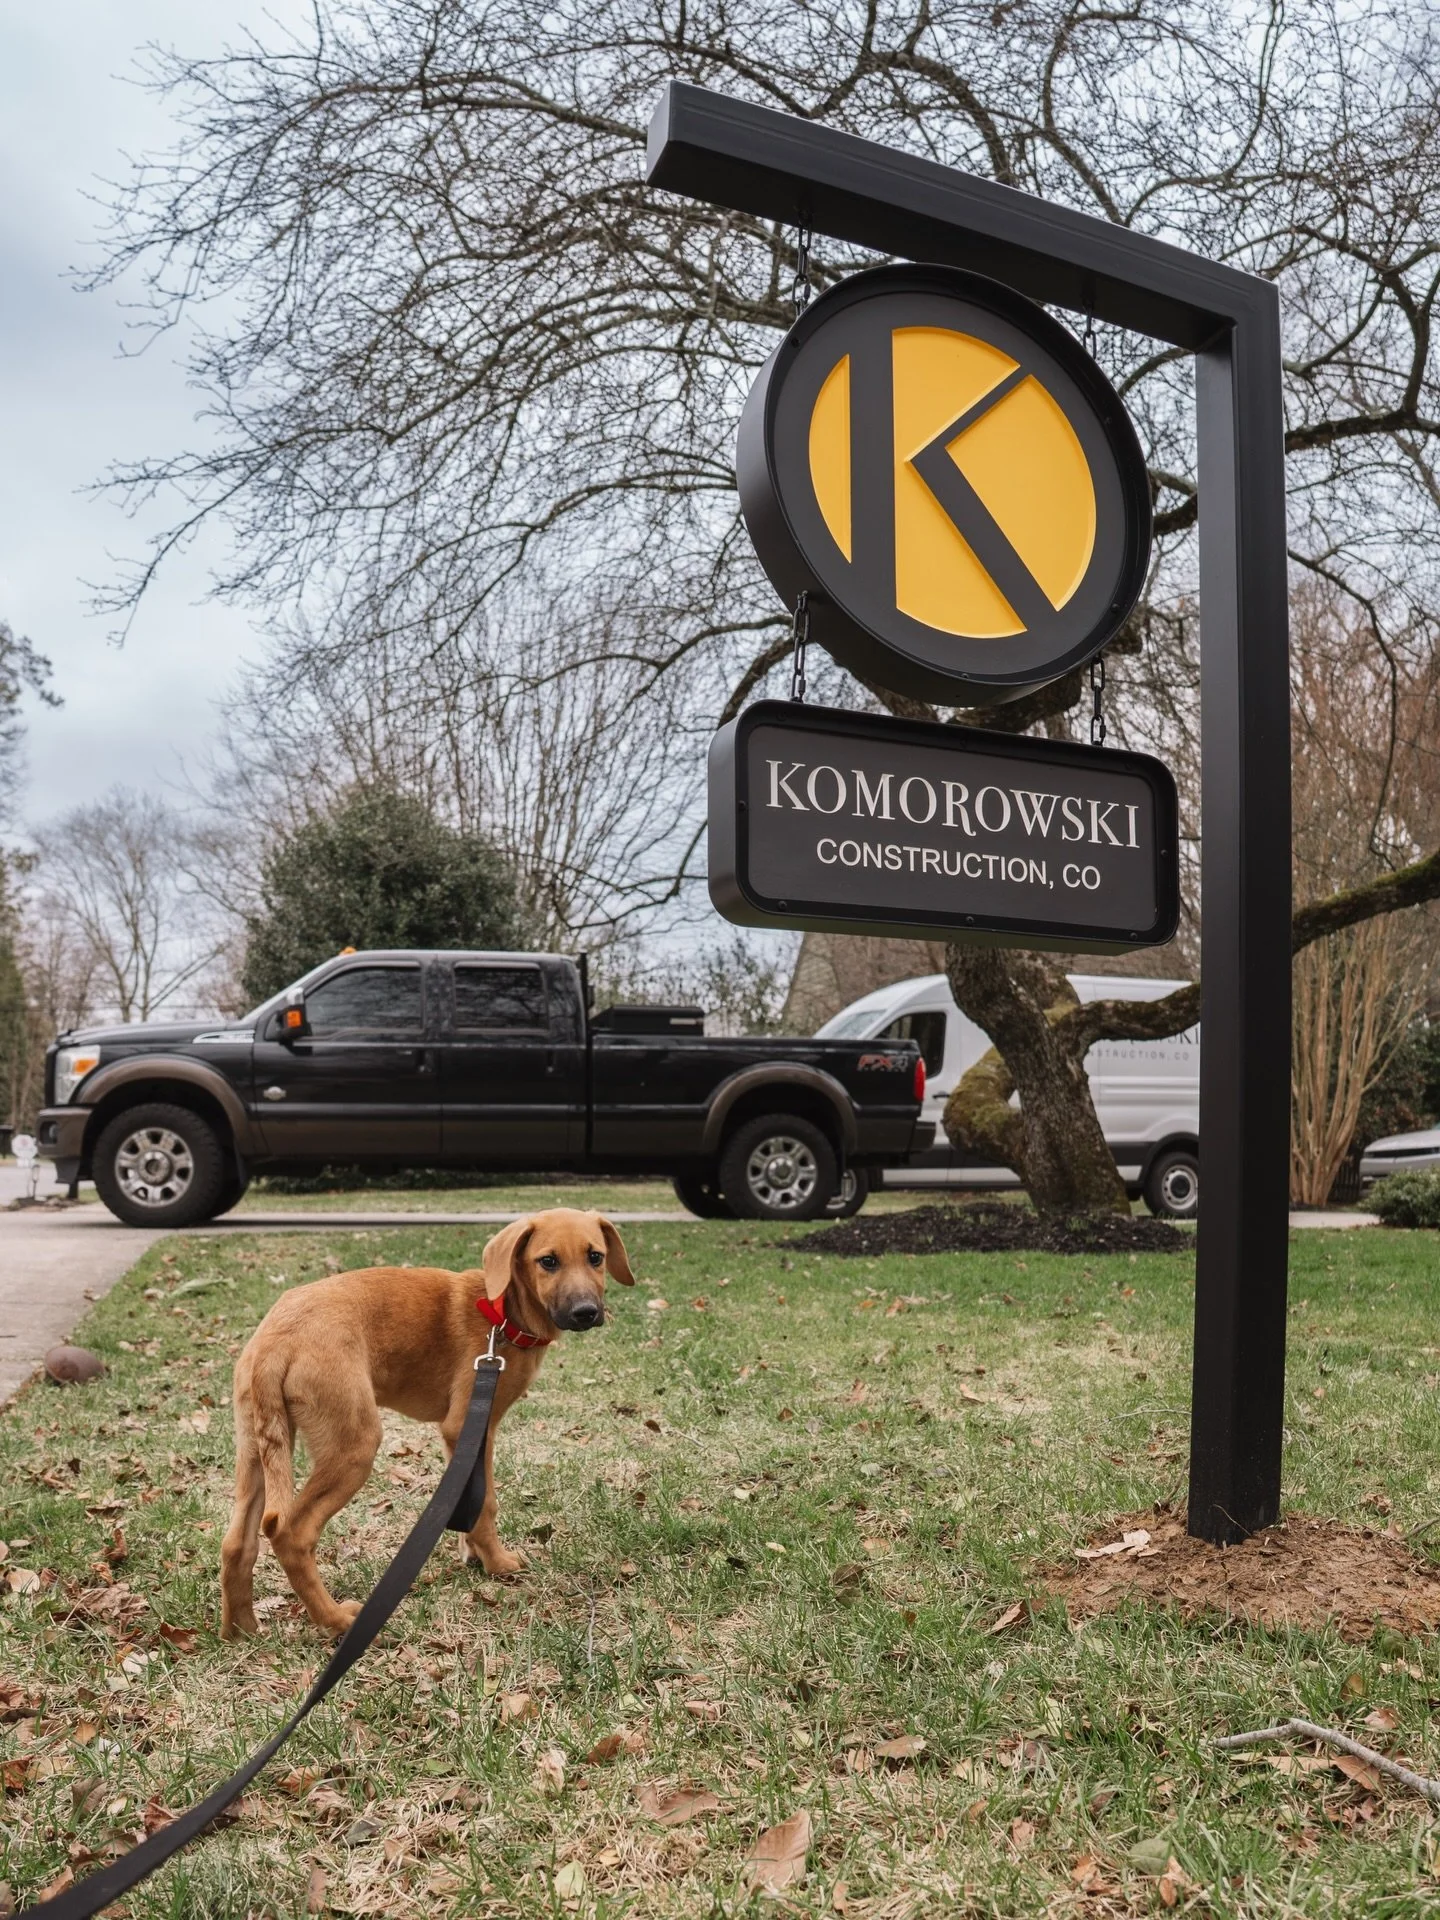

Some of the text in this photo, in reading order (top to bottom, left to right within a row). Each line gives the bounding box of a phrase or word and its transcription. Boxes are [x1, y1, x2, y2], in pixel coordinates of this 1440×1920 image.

[832, 325, 1078, 638] K
[765, 759, 1141, 849] KOMOROWSKI
[816, 837, 1101, 890] CONSTRUCTION, CO
[857, 1053, 909, 1072] FX4
